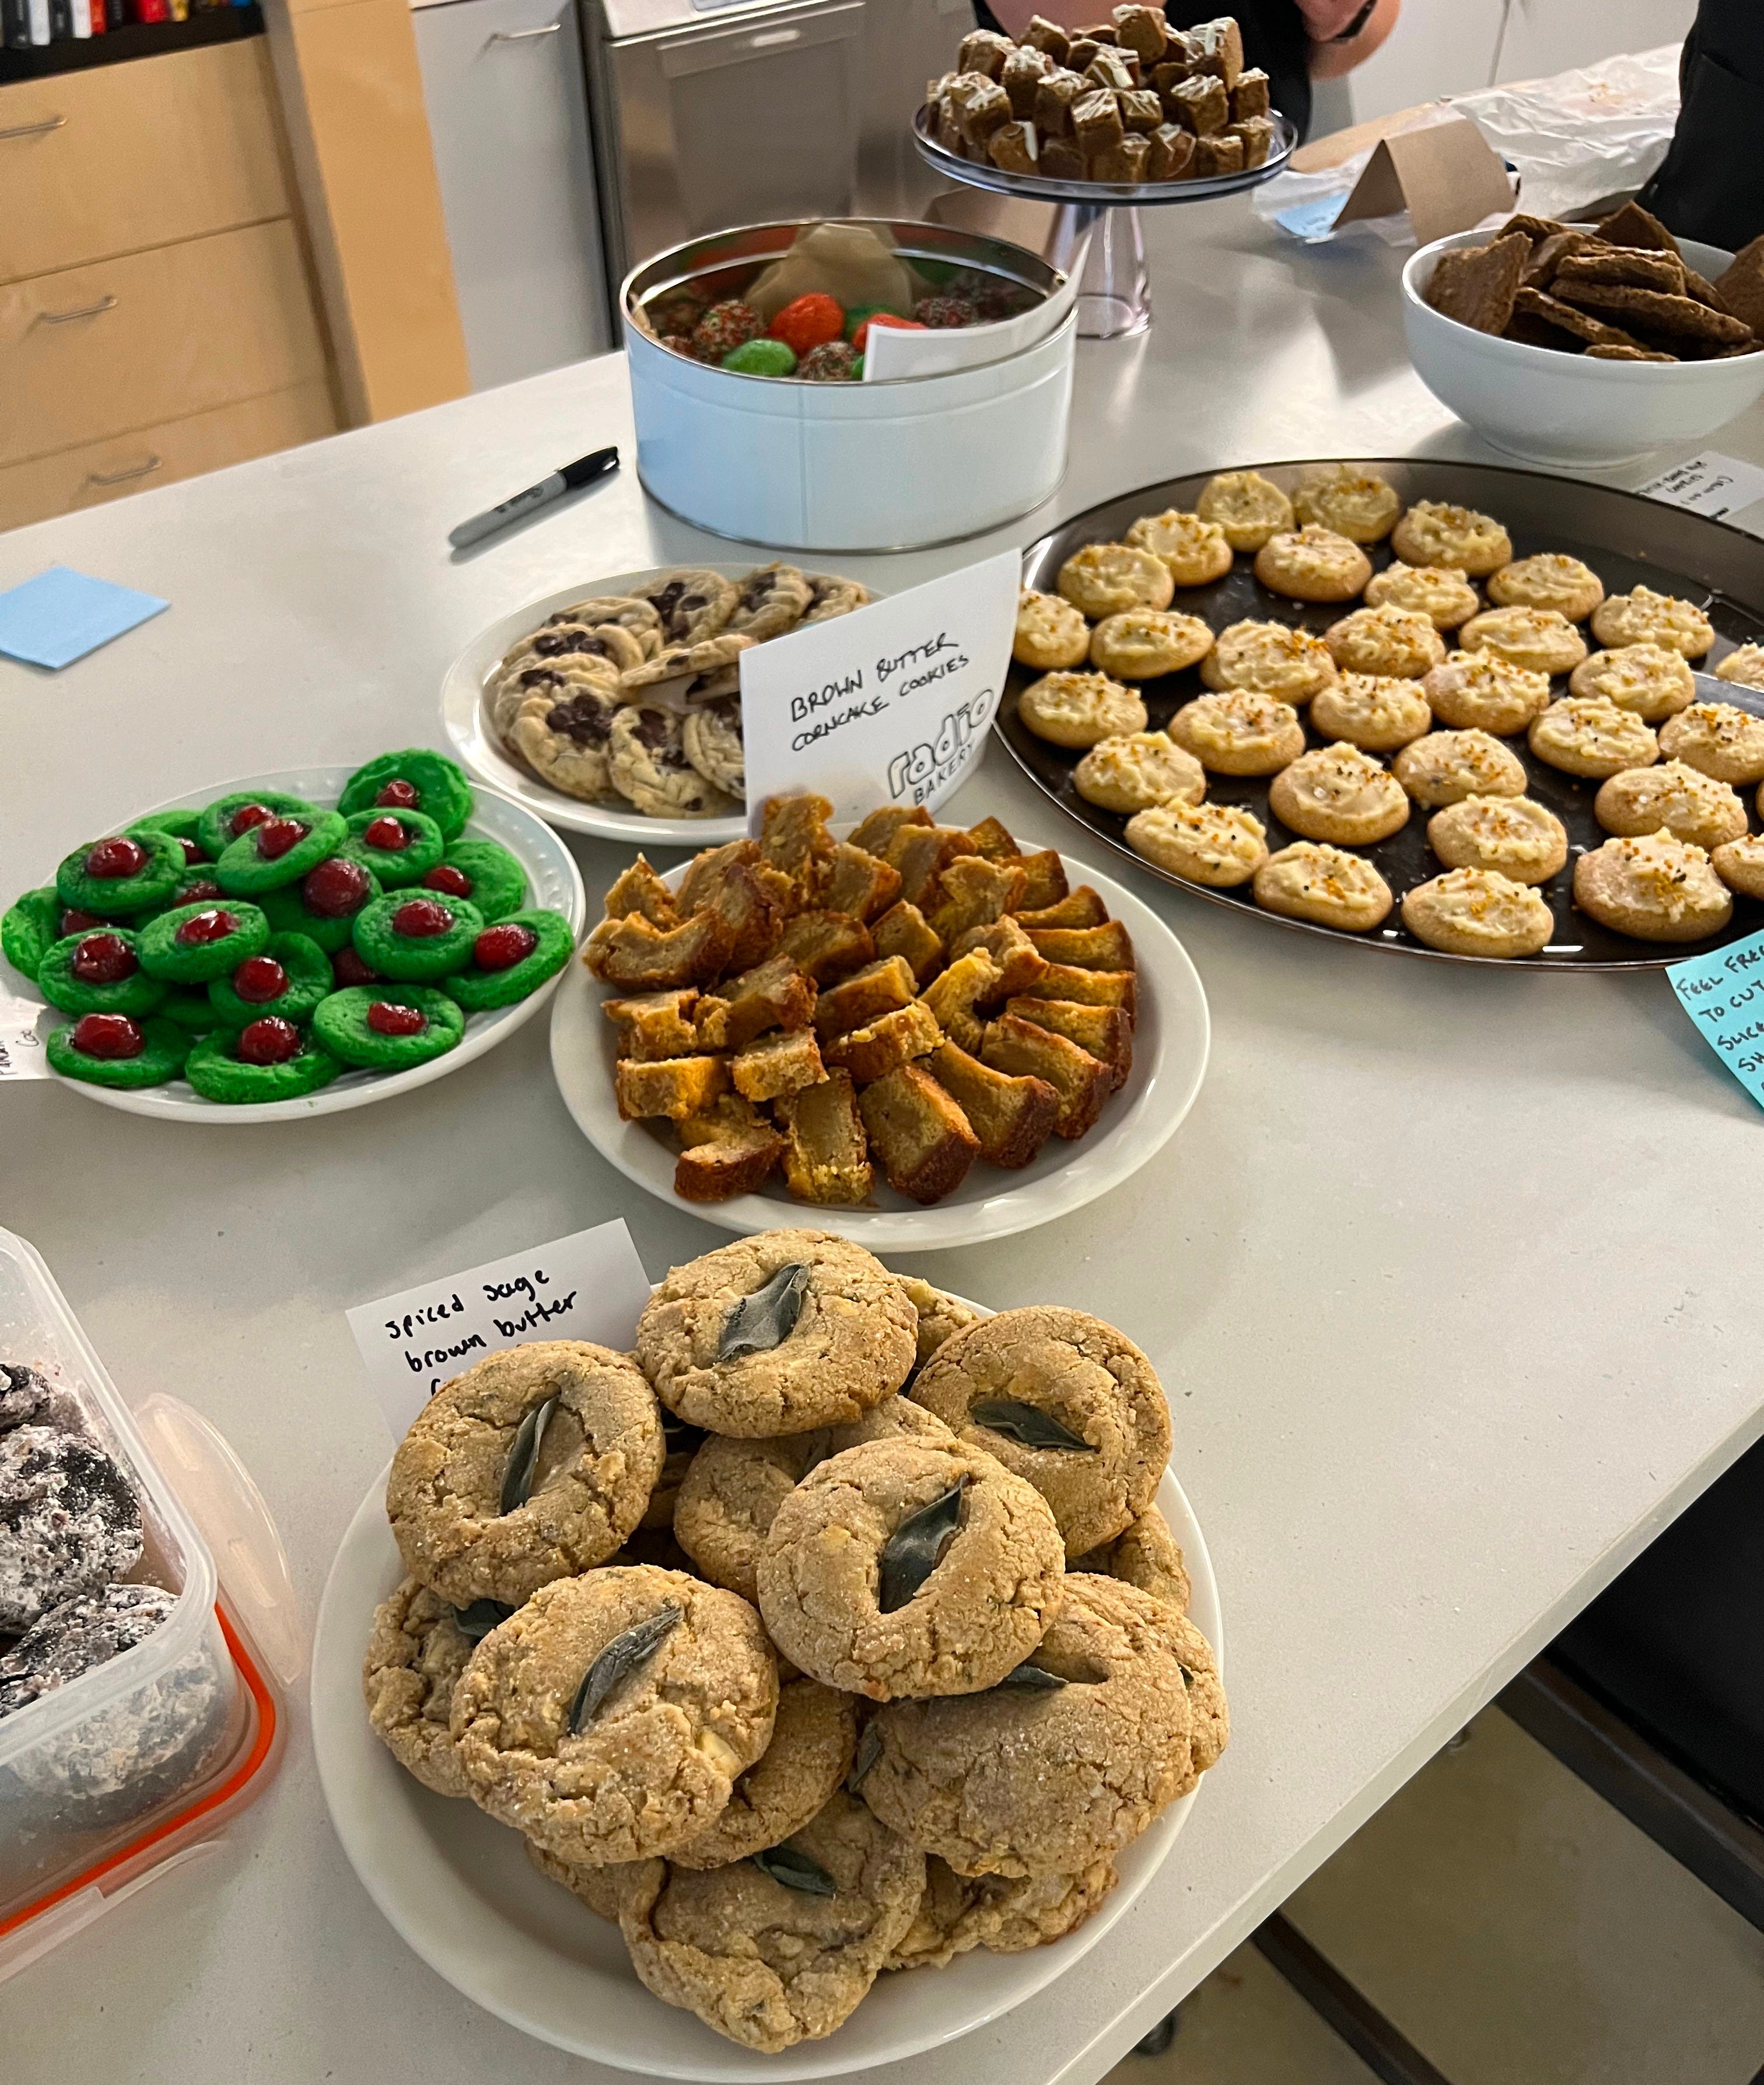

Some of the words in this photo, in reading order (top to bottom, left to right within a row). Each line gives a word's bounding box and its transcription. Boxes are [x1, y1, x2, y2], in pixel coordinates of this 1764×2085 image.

[791, 669, 863, 723] BROWN
[876, 632, 959, 683] BUTTER
[792, 696, 890, 751] CORNCAKE
[900, 655, 970, 697] COOKIES
[888, 688, 995, 799] radio
[1676, 977, 1724, 1000] FEEL
[1698, 1006, 1725, 1022] TO
[1730, 979, 1764, 1008] CUT
[385, 1293, 464, 1339] spiced
[482, 1269, 550, 1302] sage
[405, 1334, 487, 1373] brown
[493, 1290, 577, 1337] butter
